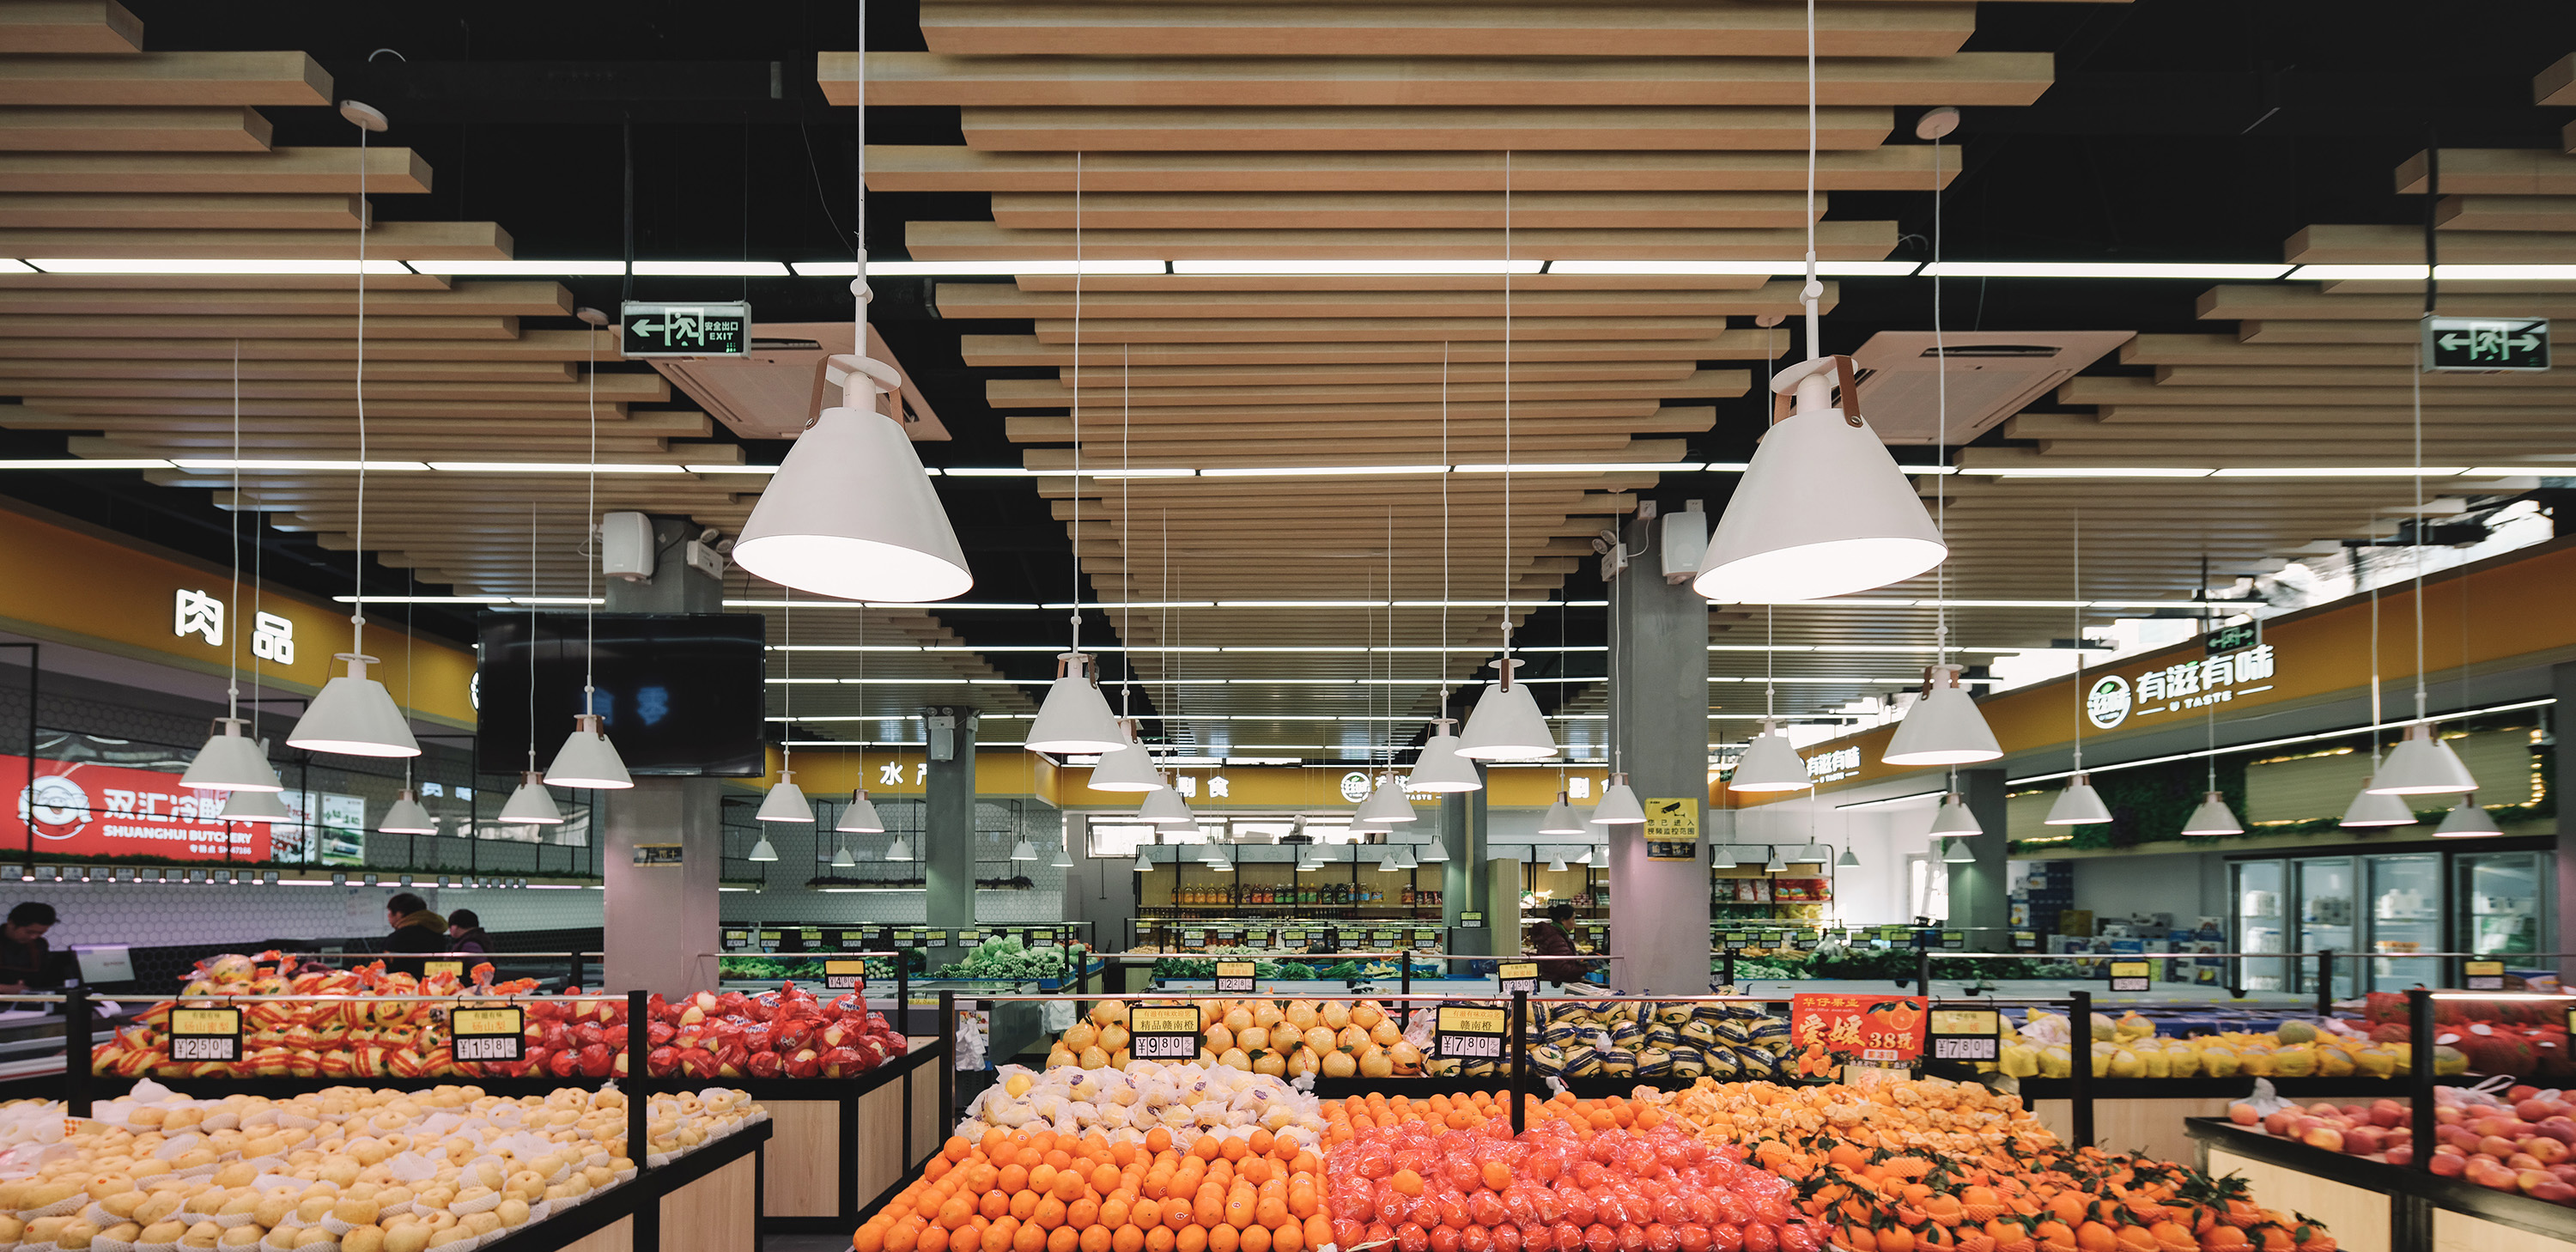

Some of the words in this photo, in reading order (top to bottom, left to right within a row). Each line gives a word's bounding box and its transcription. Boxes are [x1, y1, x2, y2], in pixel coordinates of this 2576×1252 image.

[705, 321, 738, 331] 安全出口
[709, 332, 733, 341] EXIT
[2136, 644, 2274, 704] 有滋有味
[2169, 701, 2180, 712] U
[2184, 690, 2233, 709] TASTE
[103, 788, 253, 828] 双汇冷鲜
[102, 824, 187, 841] SHUANGHUI
[189, 830, 252, 844] BUTCHERY
[1140, 1019, 1194, 1030] 精品赣南橙
[1460, 1020, 1492, 1030] 赣南橙
[1138, 1037, 1180, 1054] ¥9.80
[1444, 1036, 1485, 1052] ¥7.80
